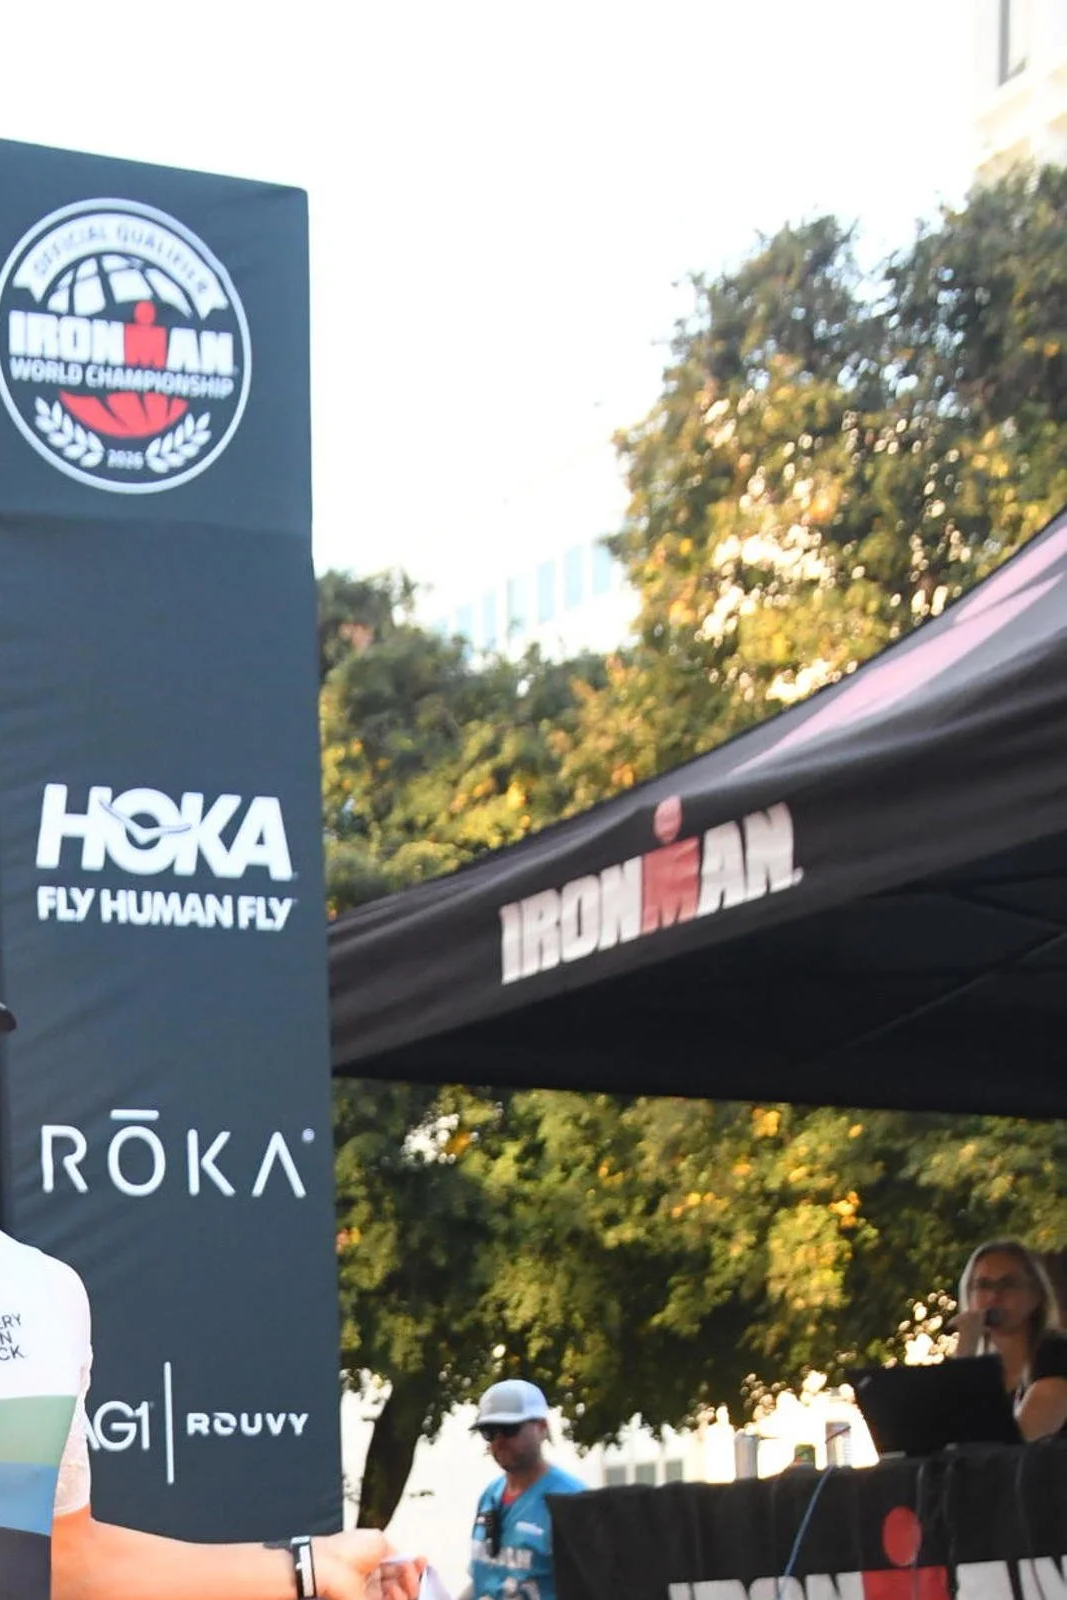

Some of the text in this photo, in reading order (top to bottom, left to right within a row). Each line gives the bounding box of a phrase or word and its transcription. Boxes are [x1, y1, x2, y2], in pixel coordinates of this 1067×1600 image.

[9, 300, 234, 376] IRONMAN
[9, 357, 234, 398] WORLD CHAMPIONSHIP
[36, 784, 295, 881] HOKA
[37, 886, 293, 931] FLY HUMAN FLY
[499, 796, 799, 985] IRONMAN
[186, 1412, 309, 1437] ROUVY
